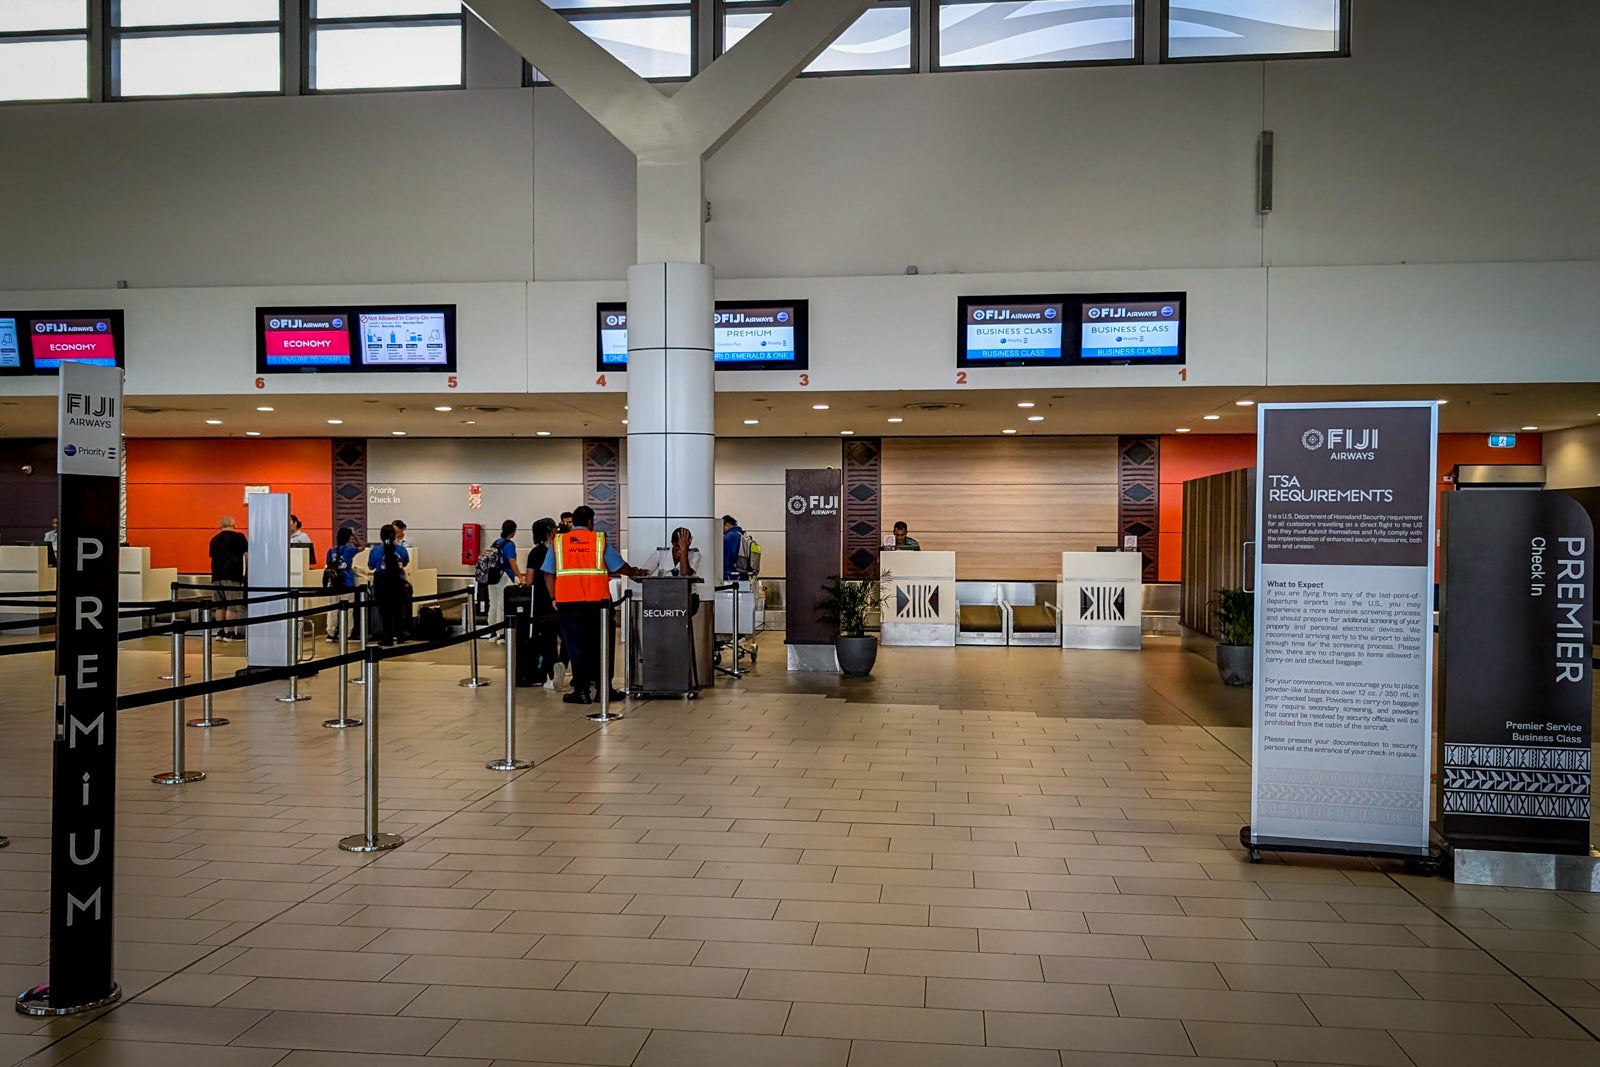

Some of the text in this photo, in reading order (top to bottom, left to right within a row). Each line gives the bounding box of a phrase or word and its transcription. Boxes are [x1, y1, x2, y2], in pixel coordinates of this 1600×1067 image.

[986, 310, 1010, 319] FIJI
[1101, 308, 1125, 317] FIJI
[281, 319, 302, 328] FIJI
[722, 314, 744, 323] FIJI
[46, 324, 67, 332] FIJI
[800, 374, 809, 386] 3
[956, 372, 967, 384] 2
[1178, 368, 1187, 381] 1
[255, 377, 265, 389] 6
[448, 376, 458, 388] 5
[596, 374, 606, 387] 4
[67, 393, 114, 417] FIJI
[69, 418, 112, 428] AIRWAYS
[1328, 429, 1379, 450] FIJI
[79, 447, 106, 457] Priority
[1330, 452, 1375, 460] AIRWAYS
[1269, 475, 1300, 487] TSA
[369, 486, 396, 496] Priority
[1269, 489, 1393, 503] REQUIREMENTS
[369, 496, 392, 504] Check
[810, 496, 838, 508] FIJI
[1531, 536, 1546, 597] Check In
[1298, 581, 1323, 589] Expect
[643, 609, 686, 618] SECURITY
[1556, 537, 1585, 683] PREMIER
[1506, 721, 1582, 732] Premier Service
[1512, 733, 1582, 743] Business Class
